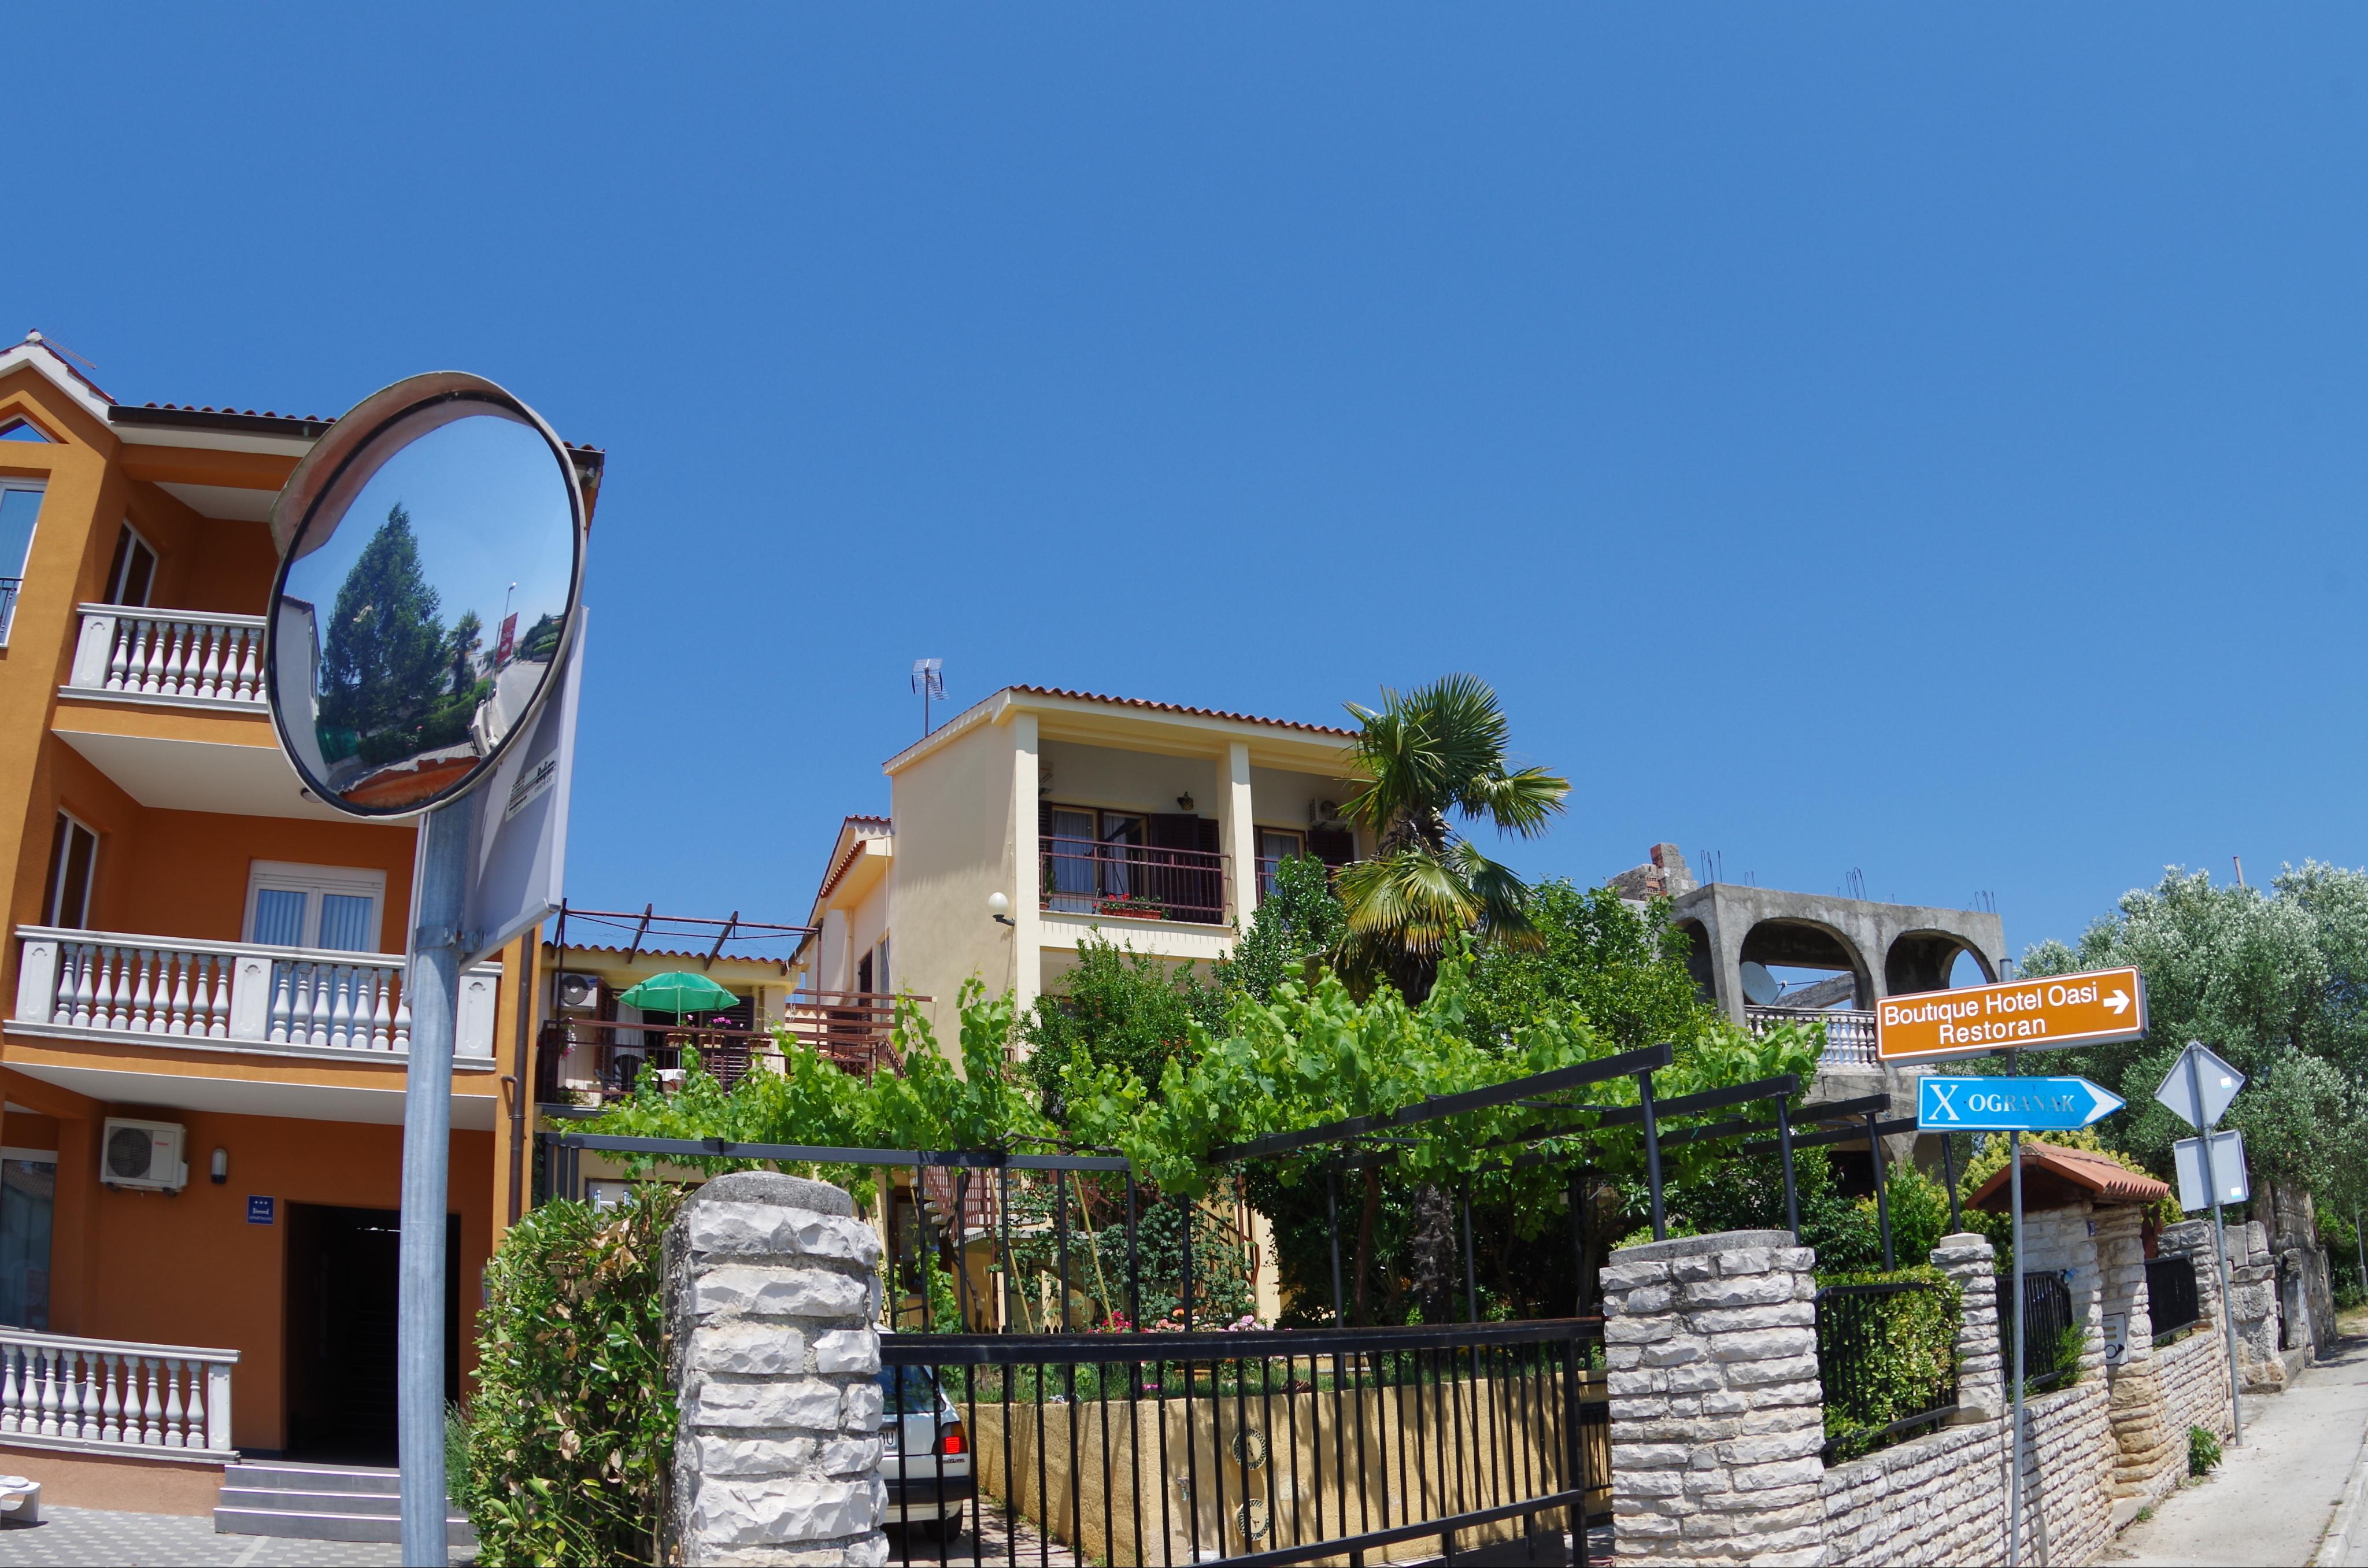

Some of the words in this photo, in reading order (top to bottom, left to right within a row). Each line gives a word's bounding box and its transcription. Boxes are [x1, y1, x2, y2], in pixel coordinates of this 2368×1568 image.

[1885, 1000, 1979, 1026] Boutique
[1985, 988, 2043, 1015] Hotel
[2048, 981, 2097, 1007] Oasi
[1939, 1018, 2046, 1045] Restoran
[1928, 1084, 1960, 1120] X
[1968, 1093, 2075, 1112] OGRANAK
